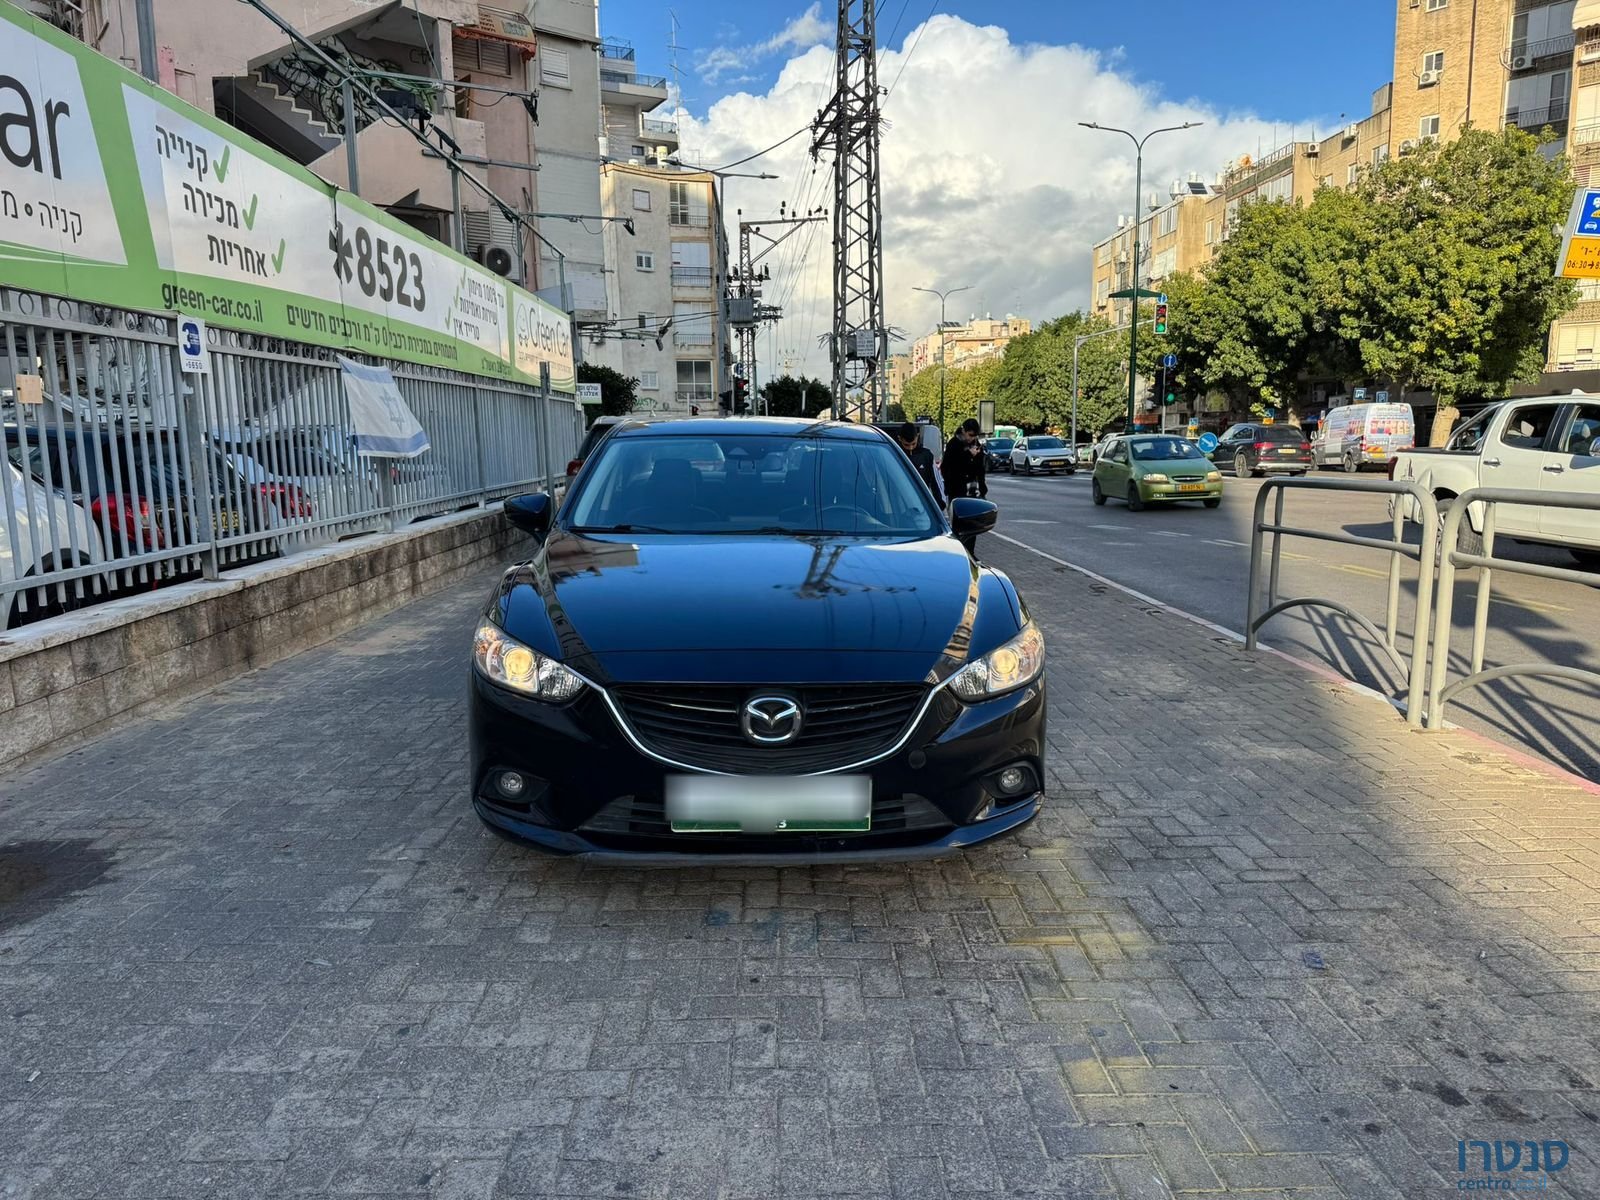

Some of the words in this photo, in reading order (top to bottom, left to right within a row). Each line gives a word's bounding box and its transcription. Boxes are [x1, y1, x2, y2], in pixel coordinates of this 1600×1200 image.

[155, 124, 208, 182] קנייה
[39, 201, 83, 243] קניה
[182, 182, 239, 229] מכירה
[207, 234, 268, 277] אחריות
[161, 283, 263, 323] green-car.co.il
[286, 304, 327, 333] חדשים
[329, 315, 361, 340] ורכבים
